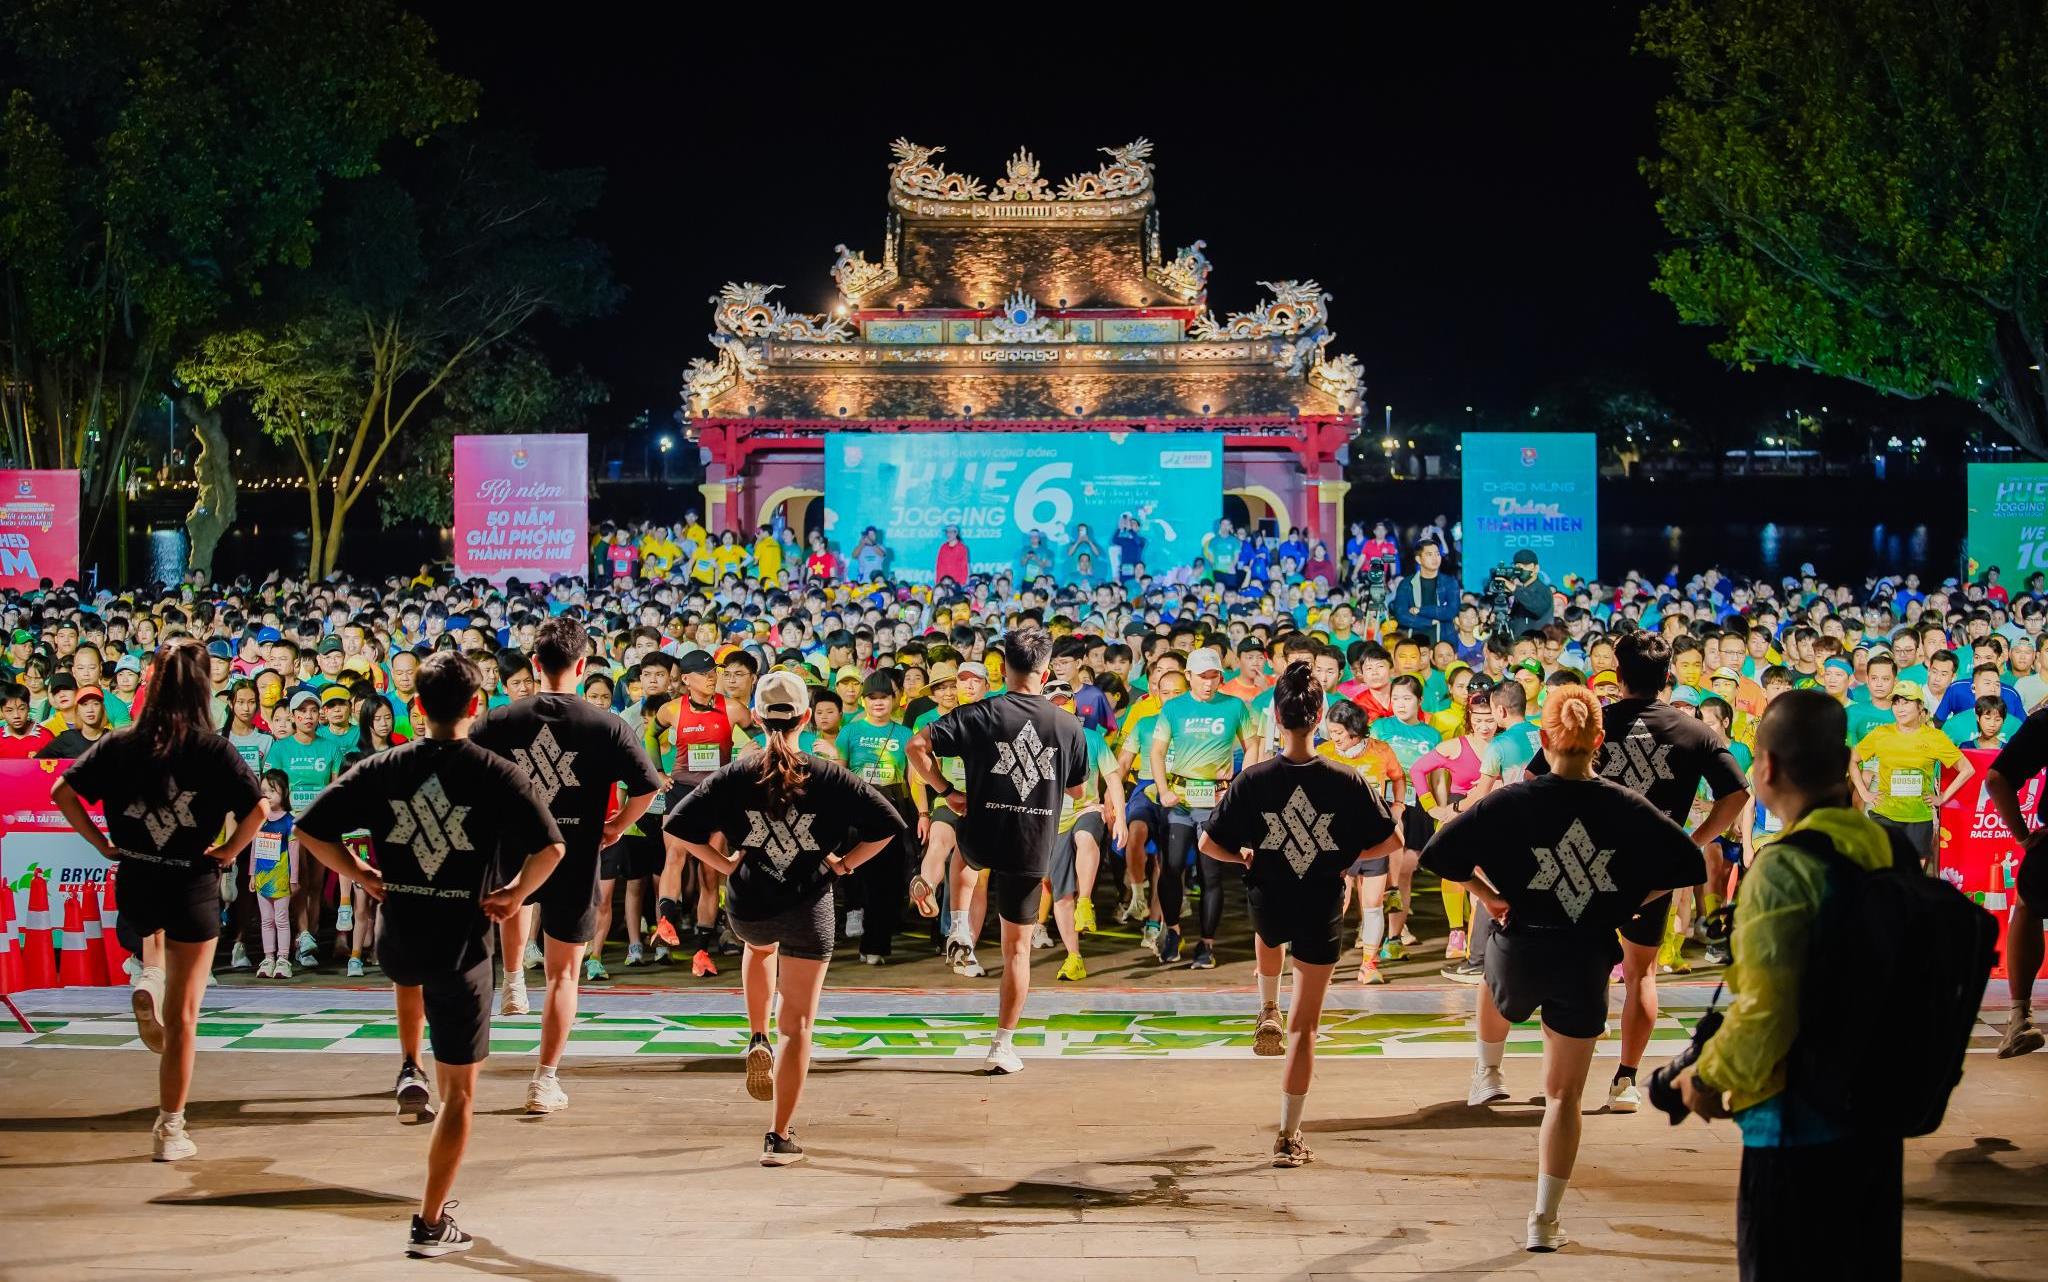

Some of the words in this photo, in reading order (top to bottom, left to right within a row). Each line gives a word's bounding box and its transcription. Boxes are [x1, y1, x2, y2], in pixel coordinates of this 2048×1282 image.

[514, 481, 562, 500] niệm
[1996, 482, 2048, 502] HUE
[895, 461, 1018, 504] HUE
[1013, 462, 1074, 536] 6
[1995, 503, 2045, 512] JOGGING
[487, 511, 510, 526] 50
[513, 507, 555, 526] NĂM
[889, 507, 1006, 527] JOGGING
[1476, 516, 1537, 532] THANH
[466, 526, 506, 545] GIẢI
[509, 525, 576, 545] PHÓNG
[1504, 534, 1554, 547] 2025
[468, 547, 512, 560] THÀNH
[1211, 717, 1225, 735] 6
[314, 757, 327, 772] 6
[1026, 807, 1054, 816] ACTIVE
[556, 817, 581, 825] CTIVE
[1970, 830, 1993, 839] RACE
[436, 888, 471, 899] ACTIVE
